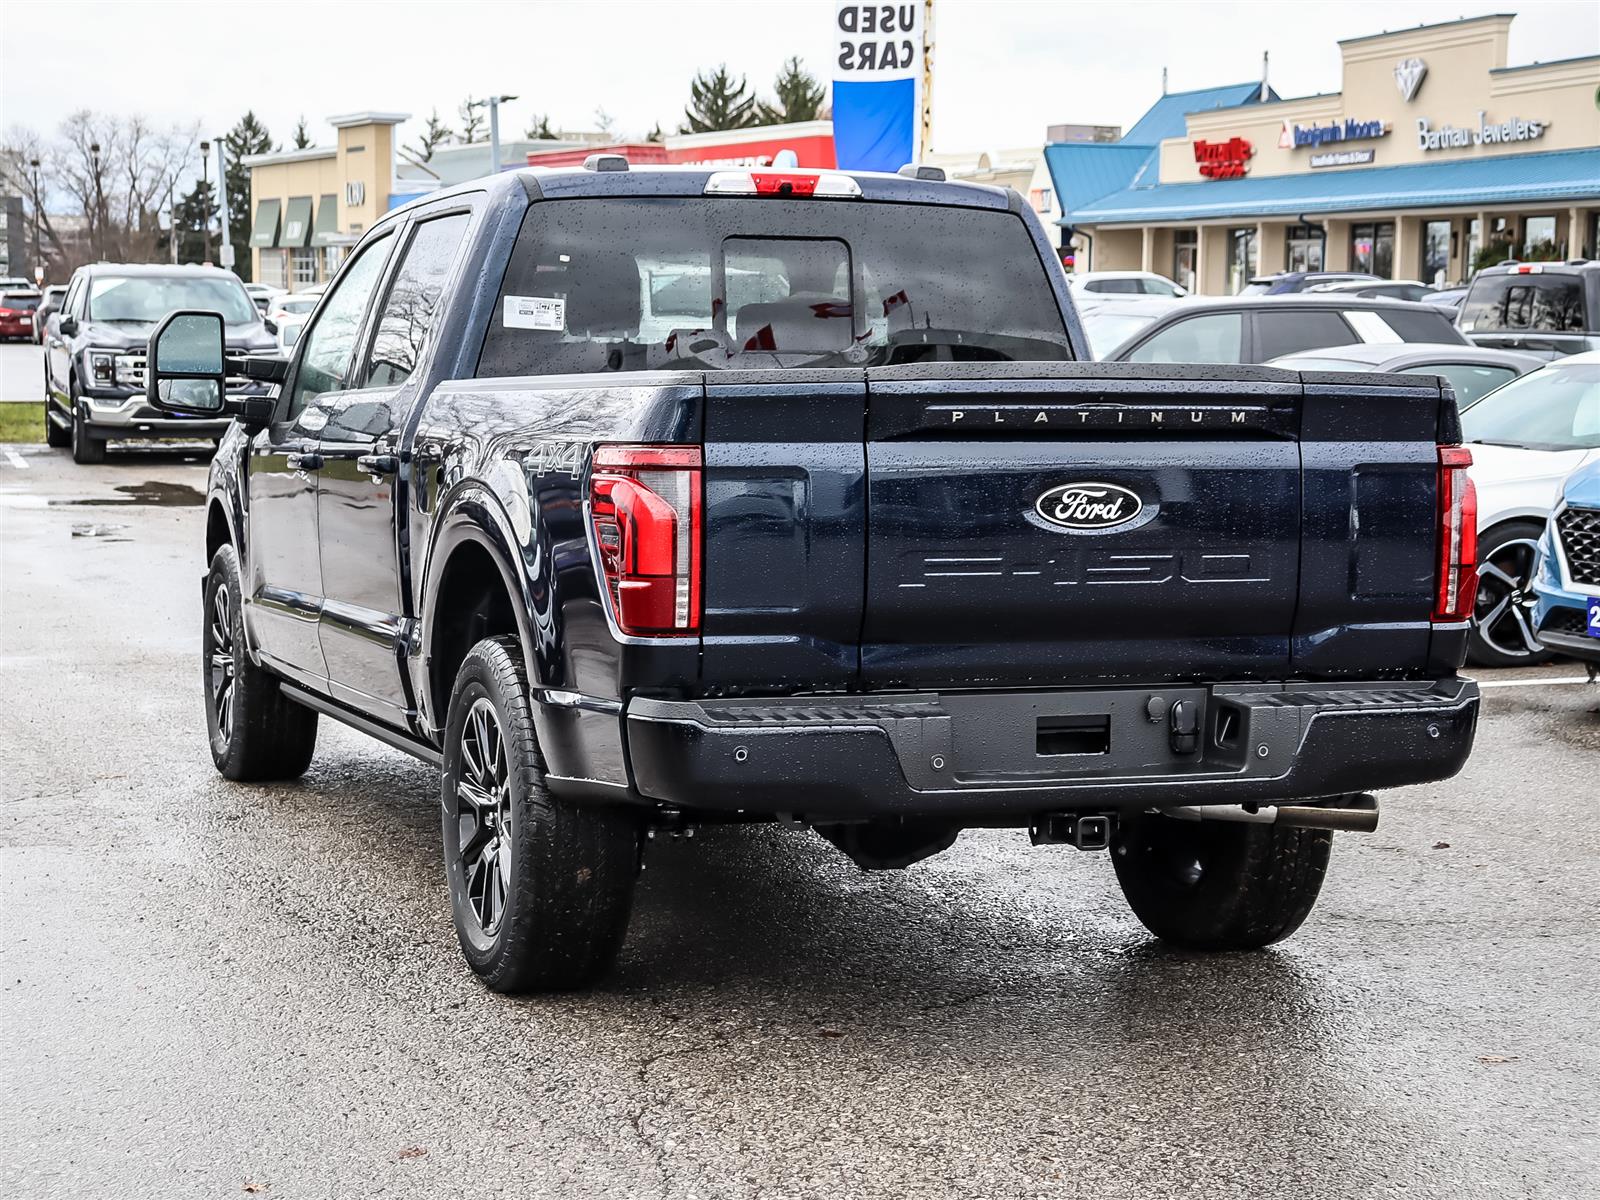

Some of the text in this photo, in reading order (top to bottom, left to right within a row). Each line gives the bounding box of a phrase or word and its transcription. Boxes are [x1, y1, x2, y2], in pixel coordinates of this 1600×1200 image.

[1294, 118, 1384, 147] Benjamin Moore
[1416, 110, 1539, 150] Barthau Jewellers
[952, 411, 1246, 423] PLATINUM
[1054, 489, 1122, 521] Ford
[899, 548, 1271, 589] F-150
